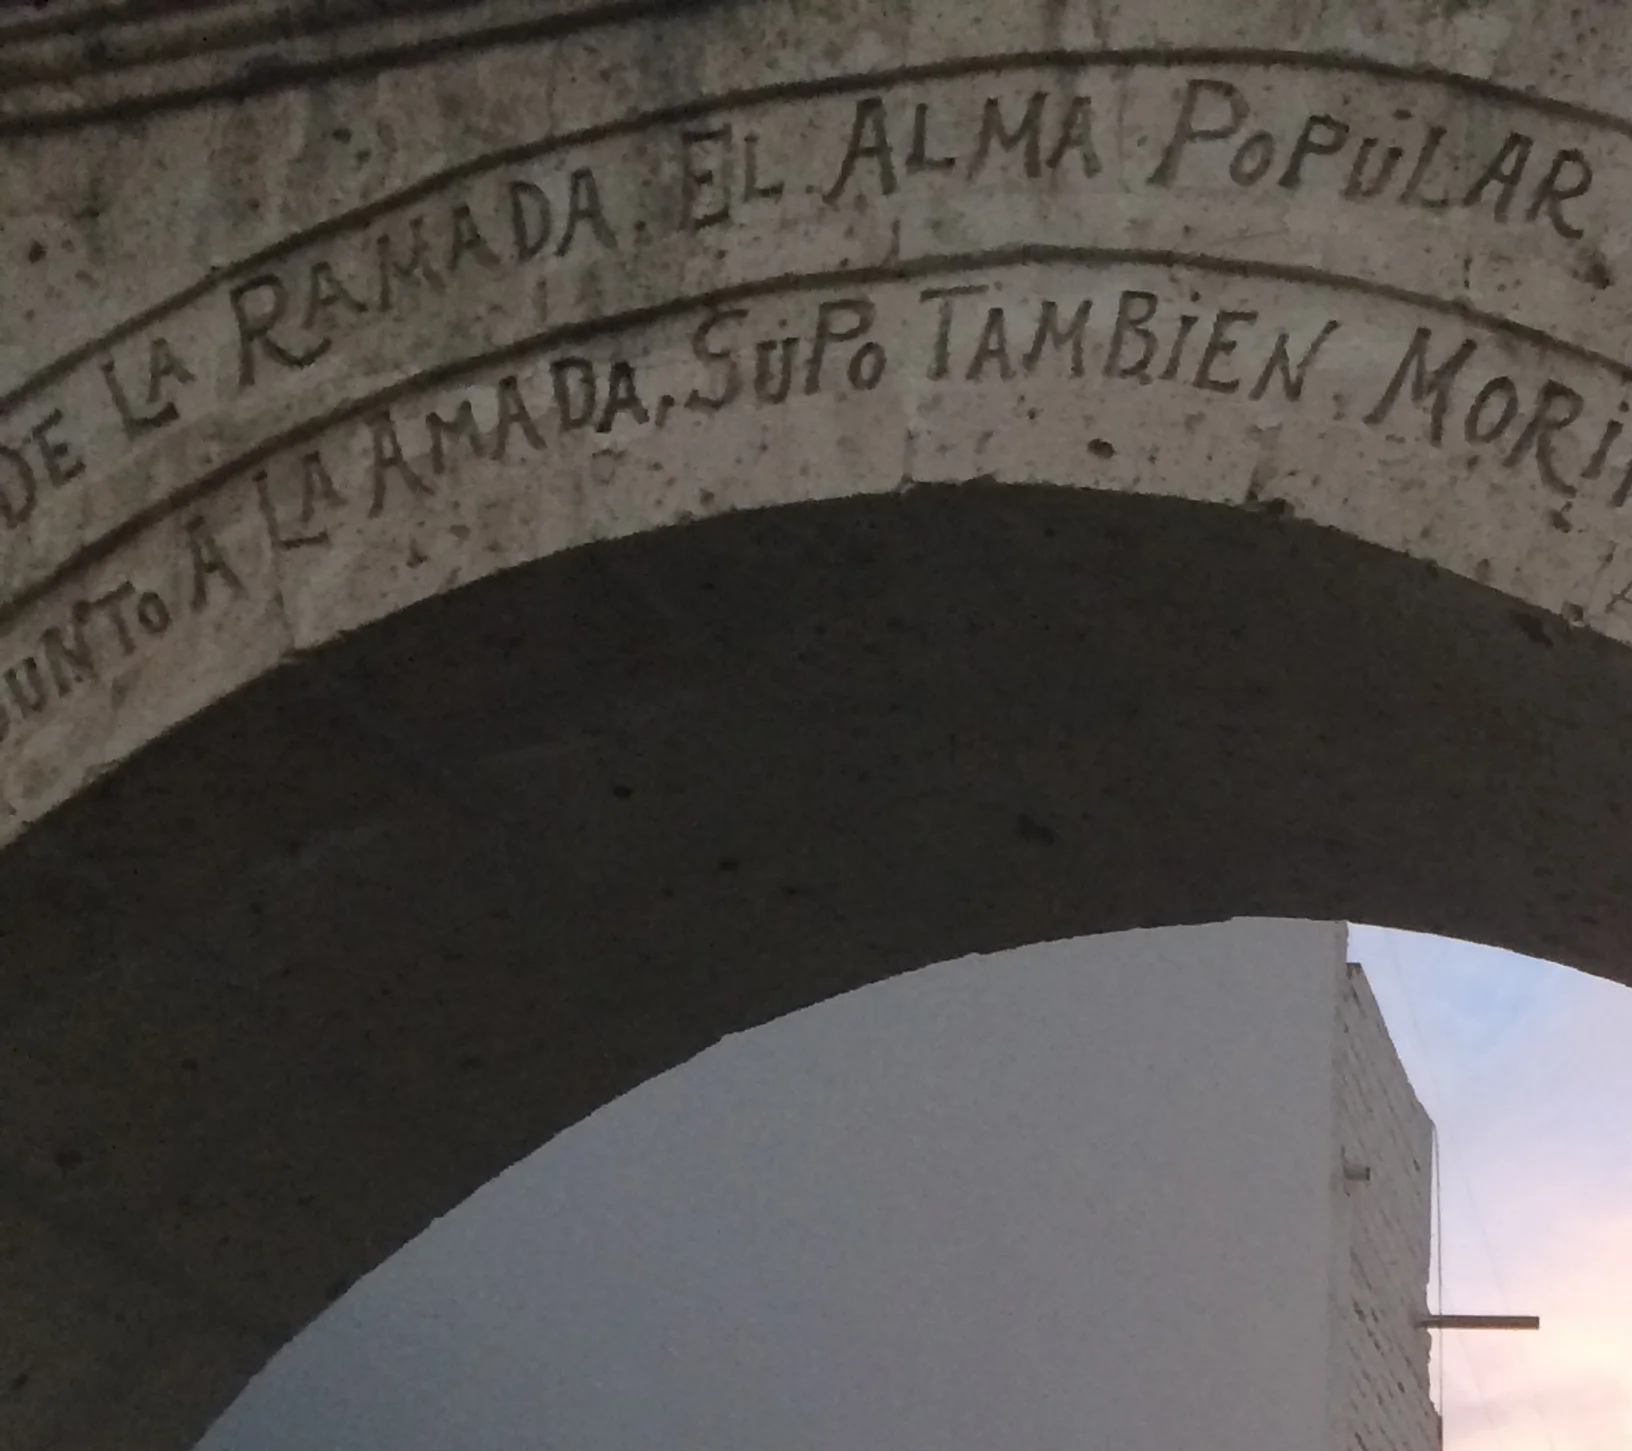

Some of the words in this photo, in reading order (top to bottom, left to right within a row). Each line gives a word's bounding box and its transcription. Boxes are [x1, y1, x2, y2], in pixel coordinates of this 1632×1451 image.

[0, 411, 86, 528] DE
[103, 338, 195, 430] LA
[680, 124, 784, 230] EL
[824, 91, 1102, 202] ALMA
[1148, 79, 1594, 240] POPULAR
[0, 581, 172, 737] UNTO
[189, 515, 246, 612] A
[253, 452, 348, 550] LA
[919, 284, 1342, 402] TAMBIEN
